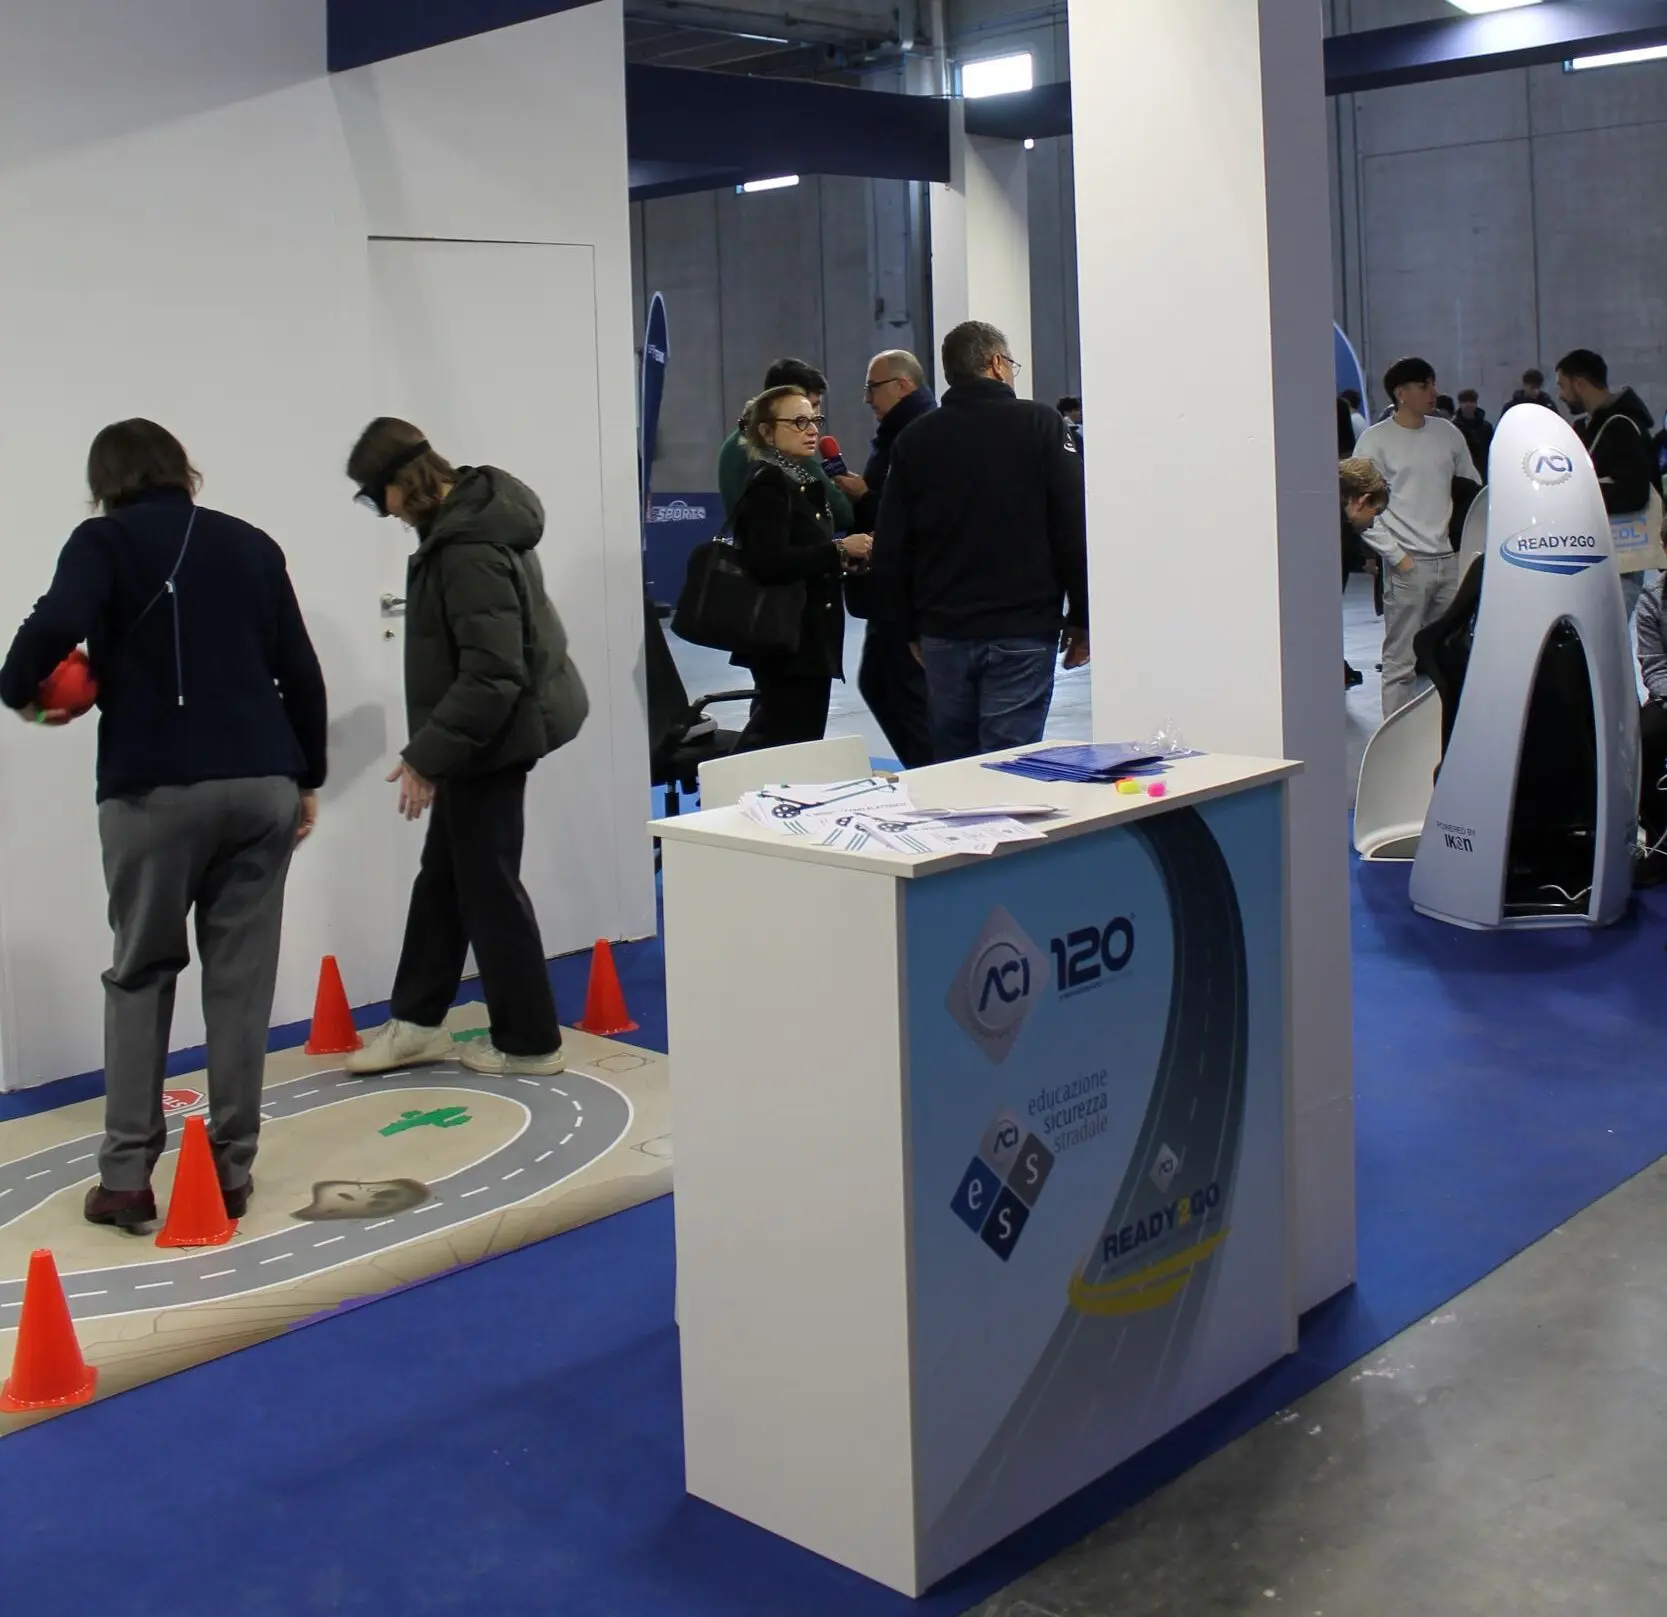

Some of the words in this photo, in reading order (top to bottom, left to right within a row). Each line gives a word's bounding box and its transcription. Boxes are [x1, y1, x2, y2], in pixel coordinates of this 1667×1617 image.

[1535, 455, 1573, 474] ACI
[1518, 535, 1595, 551] READY2GO
[977, 957, 1031, 1012] ACI
[1050, 916, 1135, 992] 120
[1028, 1069, 1108, 1117] educazione
[1044, 1092, 1108, 1135] sicurezza
[994, 1124, 1019, 1154] ACI
[1053, 1114, 1108, 1154] stradale
[967, 1178, 984, 1211] e
[1102, 1182, 1220, 1263] READY2GO
